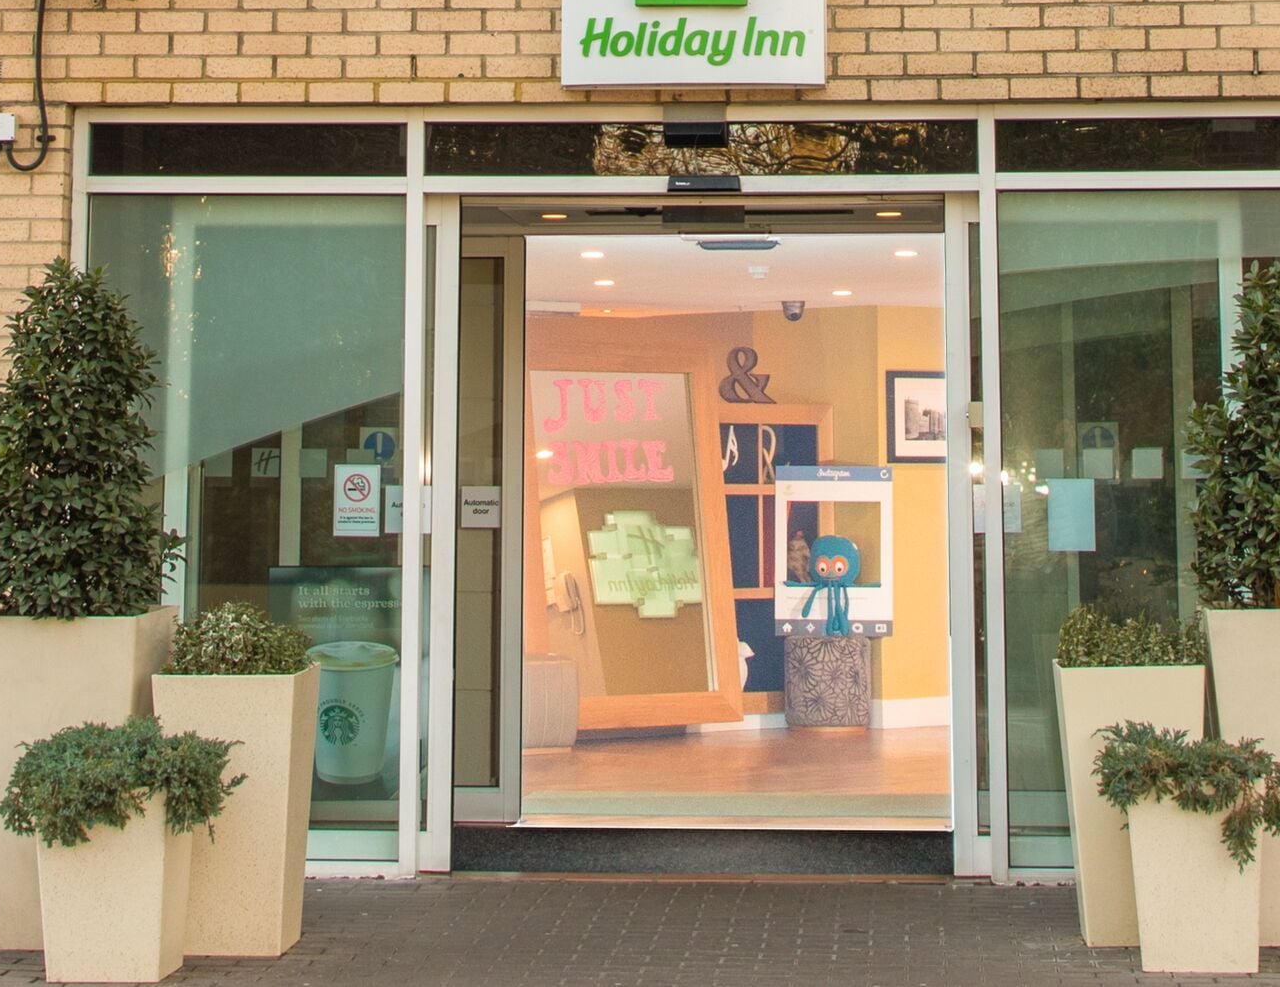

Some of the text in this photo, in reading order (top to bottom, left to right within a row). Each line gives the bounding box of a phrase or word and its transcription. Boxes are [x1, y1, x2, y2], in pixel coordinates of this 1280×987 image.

[579, 16, 807, 67] Holiday Inn
[543, 378, 666, 434] JUST
[547, 440, 675, 485] SMILE
[298, 585, 370, 596] It all starts
[298, 598, 402, 610] with the espress
